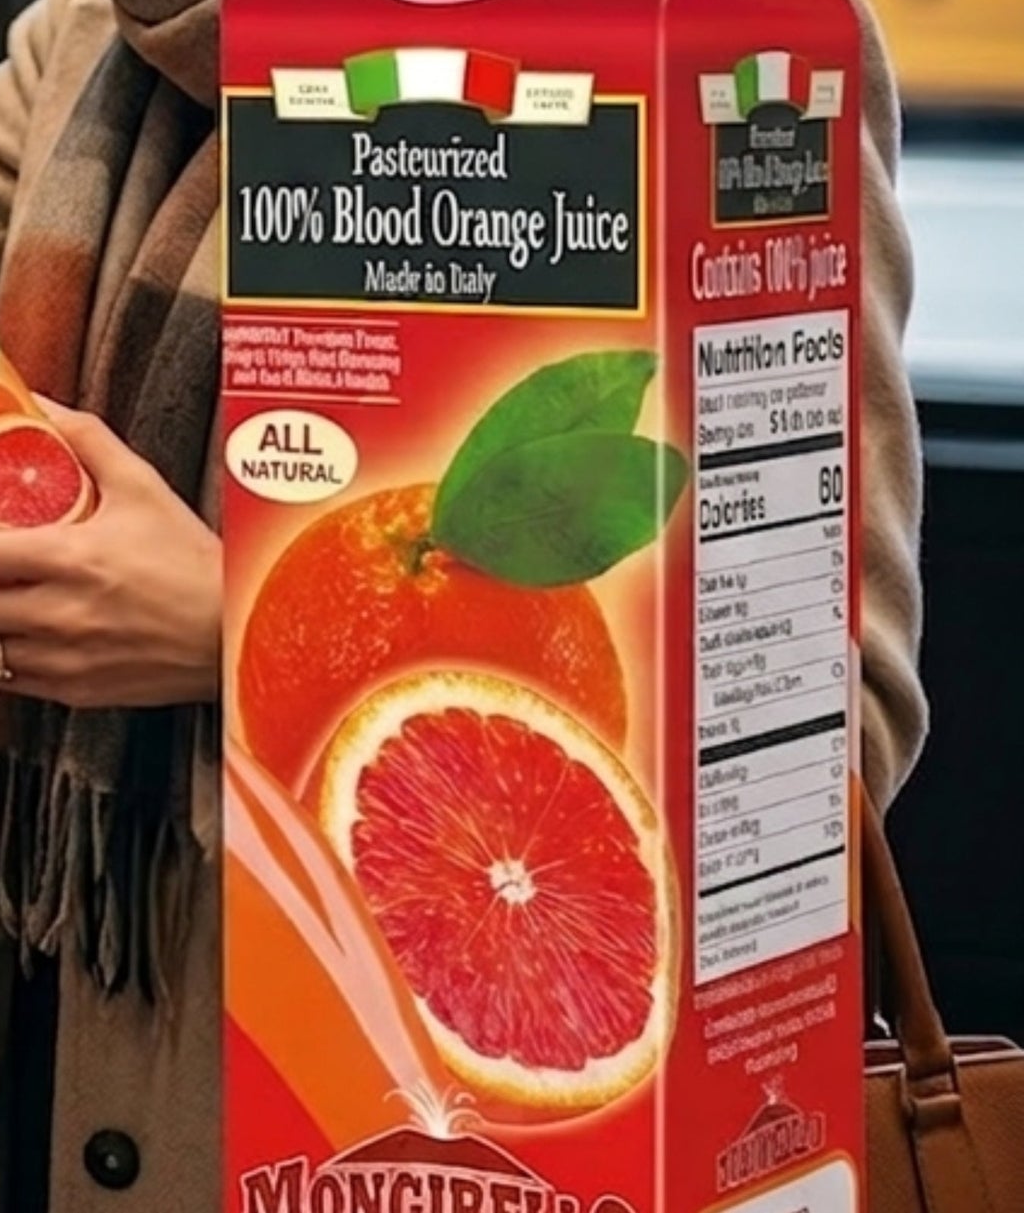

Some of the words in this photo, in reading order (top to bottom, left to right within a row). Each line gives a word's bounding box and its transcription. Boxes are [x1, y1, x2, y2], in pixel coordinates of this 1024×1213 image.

[352, 132, 507, 178] Pasteurized
[240, 186, 323, 243] 100%
[332, 186, 422, 245] Blood
[432, 189, 545, 268] Orange
[550, 190, 629, 263] Juice
[365, 260, 420, 294] Made
[692, 239, 762, 301] Contains
[258, 424, 323, 455] ALL
[241, 459, 343, 485] NATURAL
[243, 1157, 636, 1213] MONGIB
